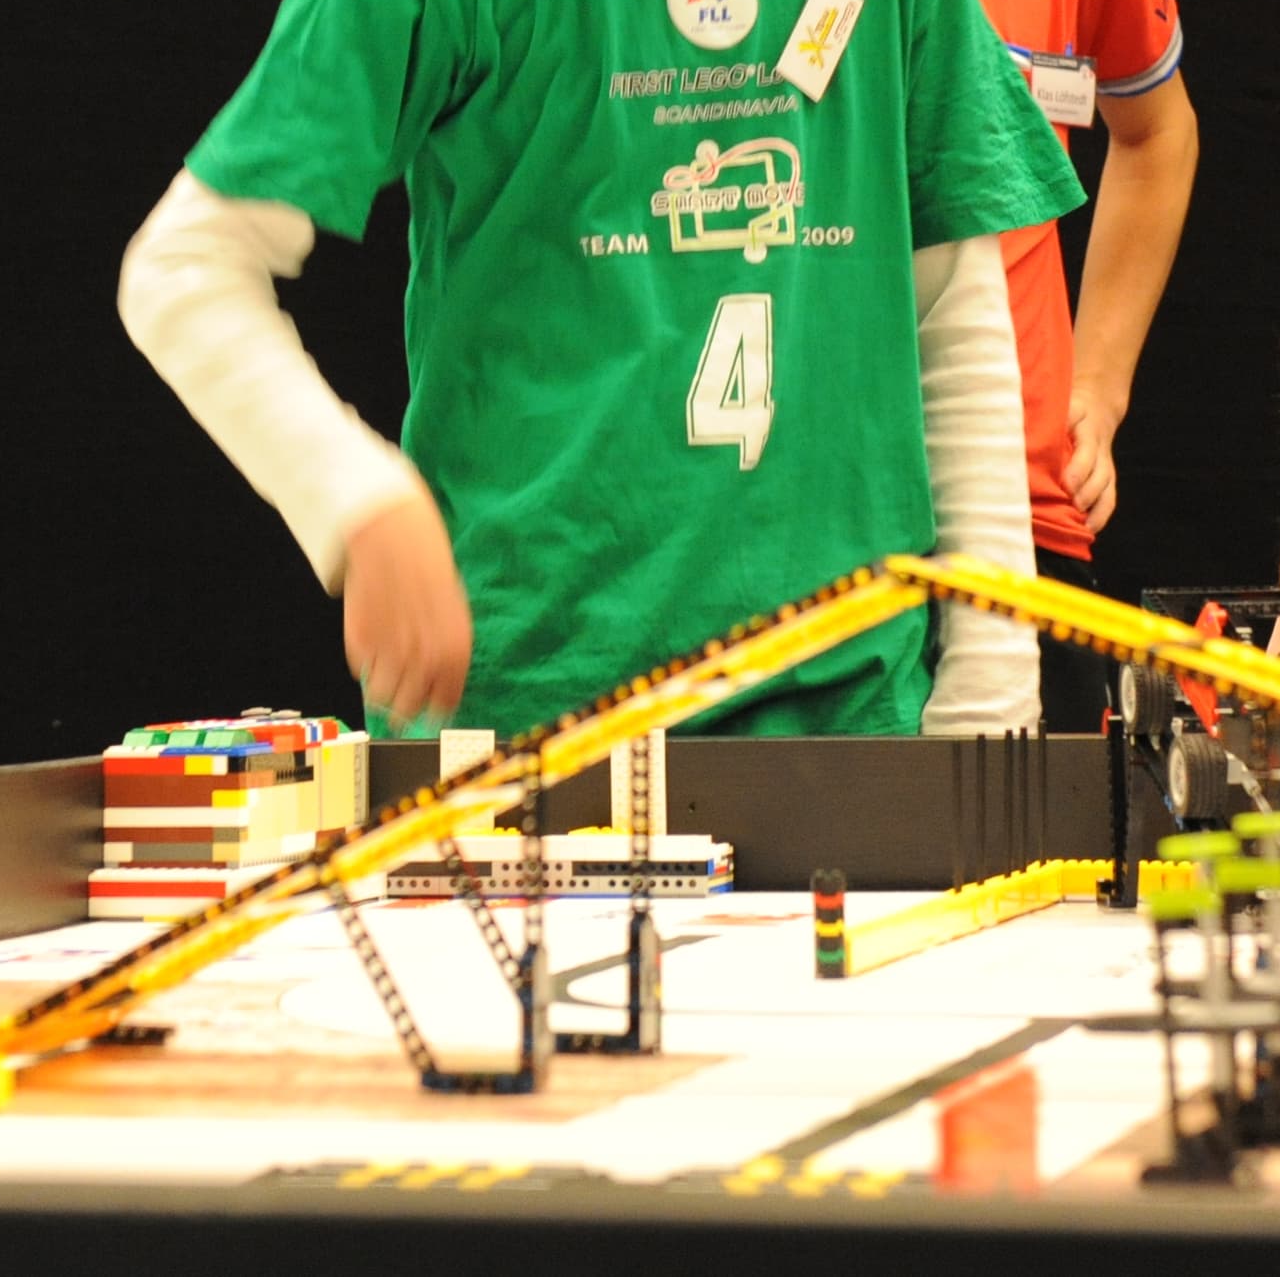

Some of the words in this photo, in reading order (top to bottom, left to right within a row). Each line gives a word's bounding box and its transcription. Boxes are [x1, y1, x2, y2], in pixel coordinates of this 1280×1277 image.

[698, 7, 732, 23] FLL
[609, 68, 677, 99] FIRST
[653, 95, 800, 125] SCANDINAVIA
[651, 185, 741, 216] SMART
[579, 233, 649, 258] TEAM
[801, 226, 856, 247] 2009
[686, 293, 774, 471] 4
